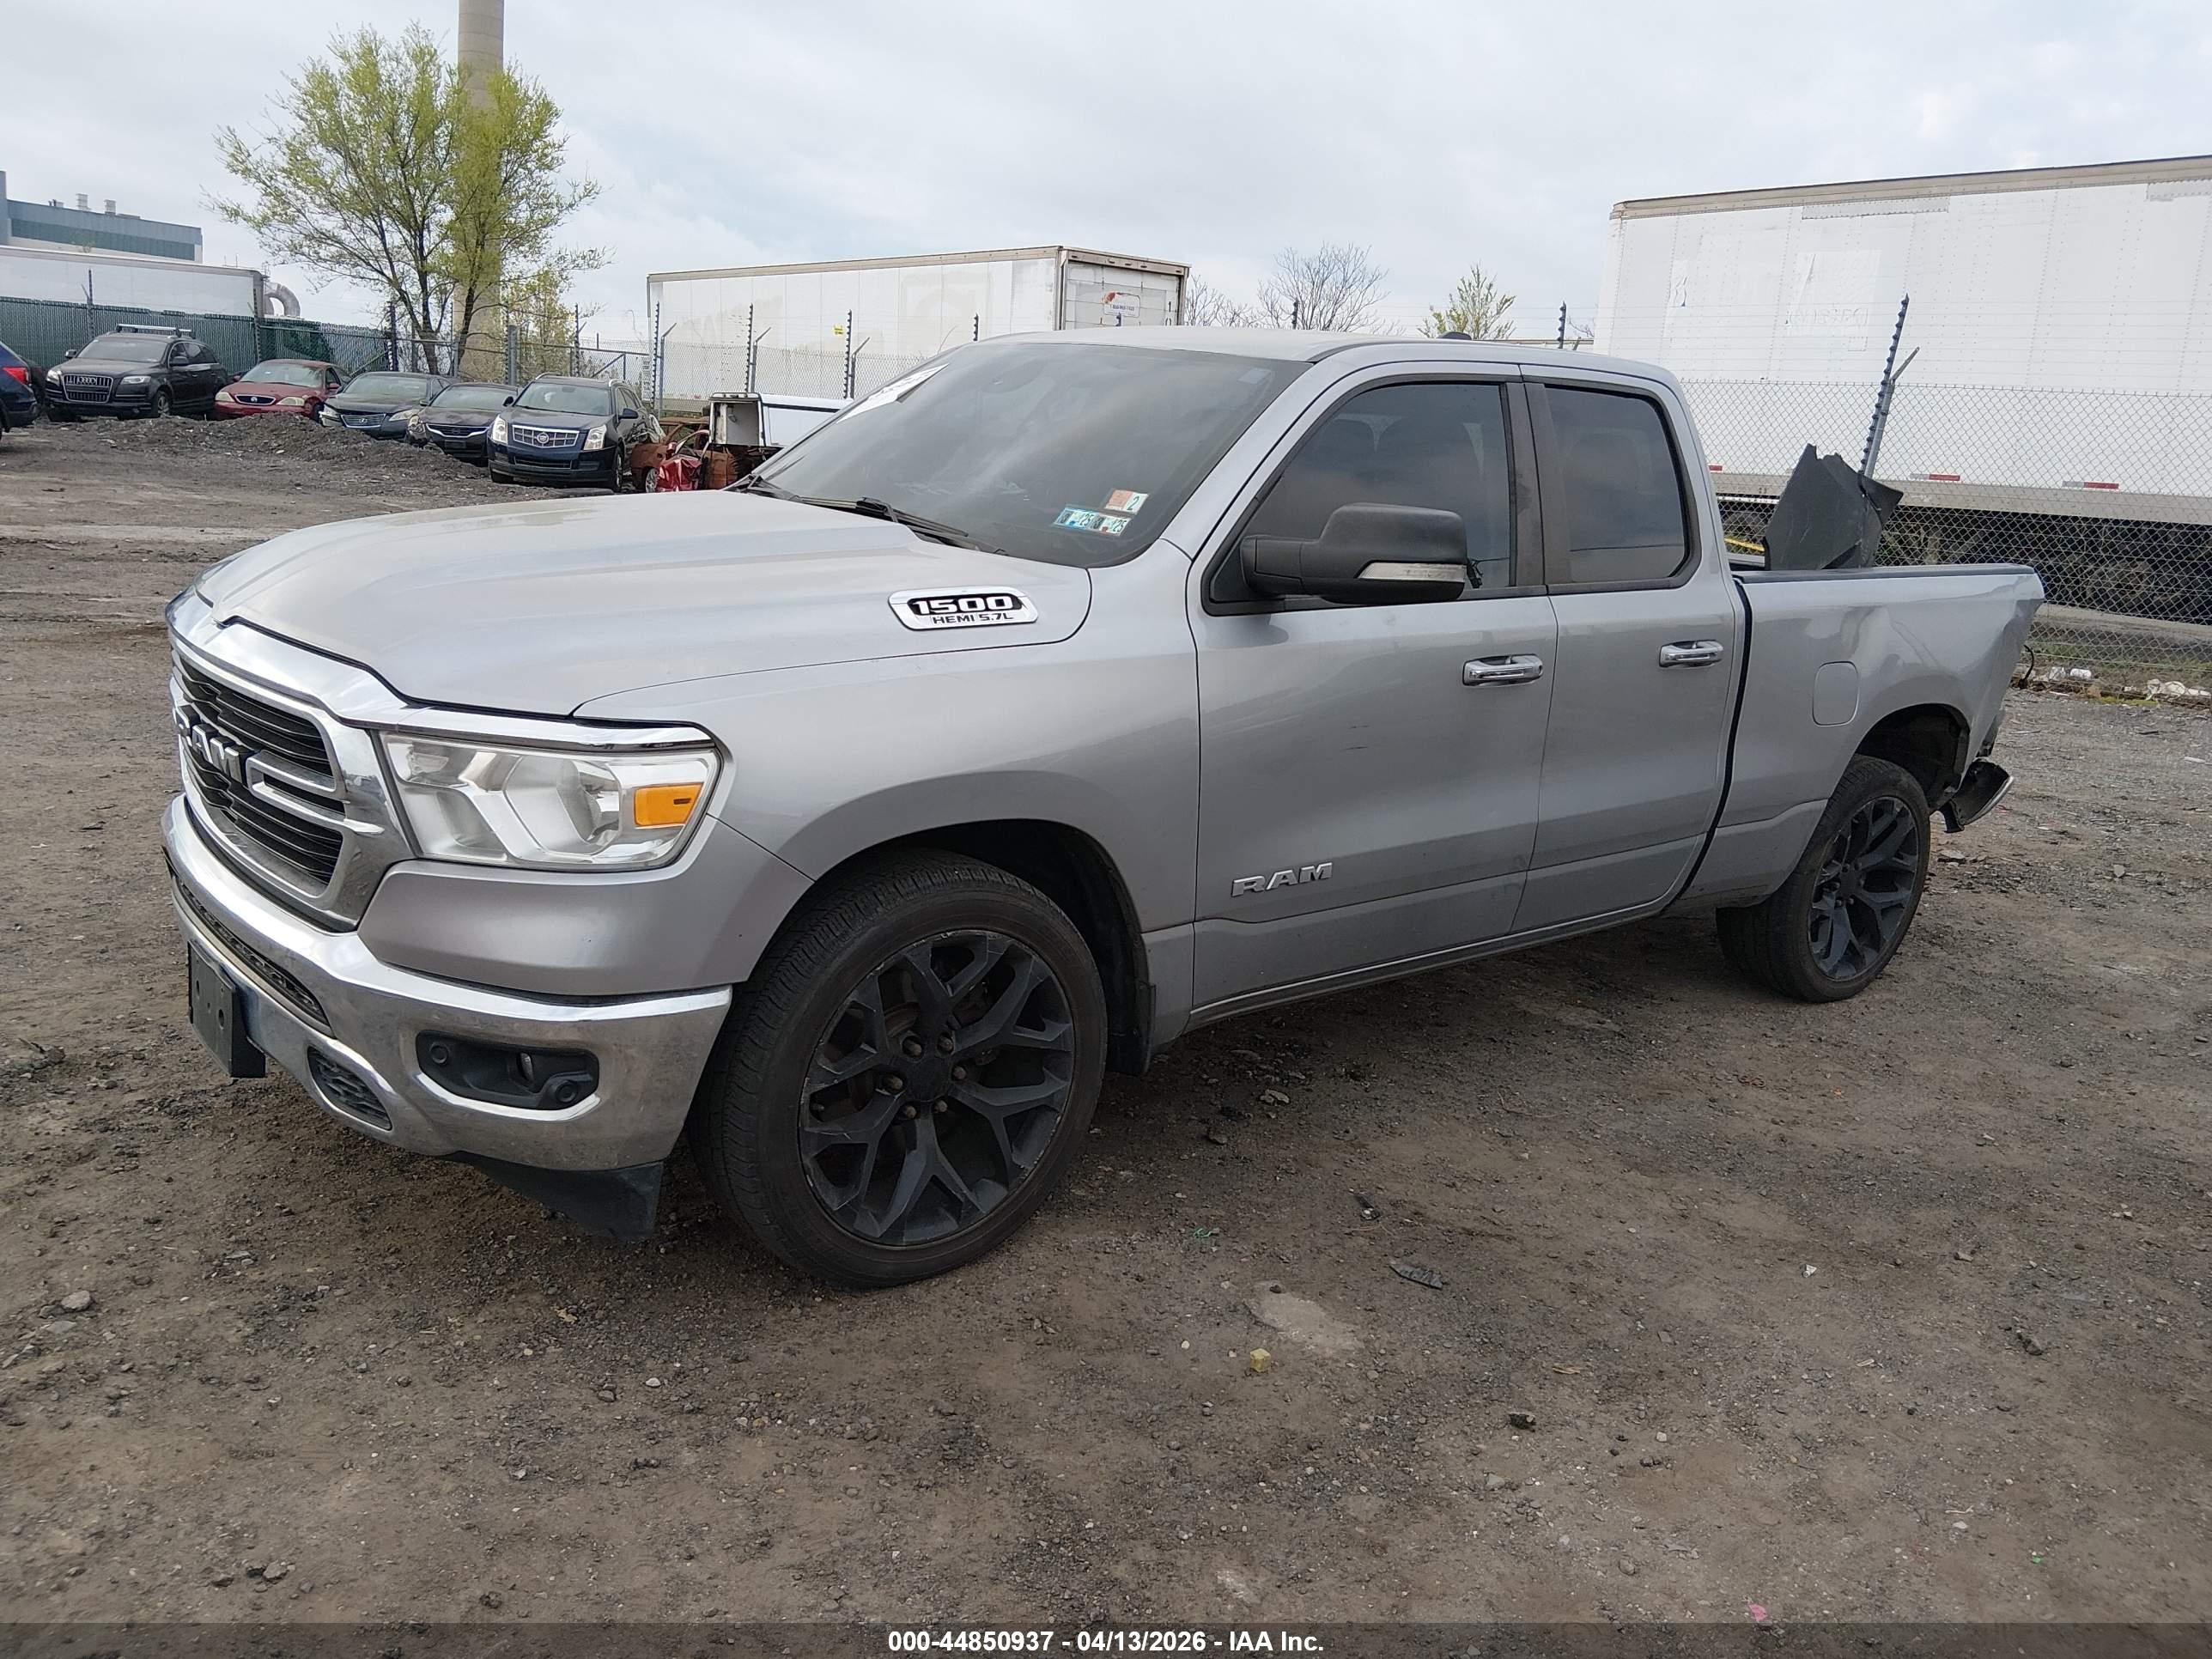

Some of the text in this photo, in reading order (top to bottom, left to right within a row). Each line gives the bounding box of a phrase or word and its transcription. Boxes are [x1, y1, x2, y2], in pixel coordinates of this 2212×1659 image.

[912, 596, 1013, 615] 1500
[933, 612, 1015, 624] HEMI 5.7L
[172, 704, 244, 784] RAM
[1231, 862, 1333, 897] RAM
